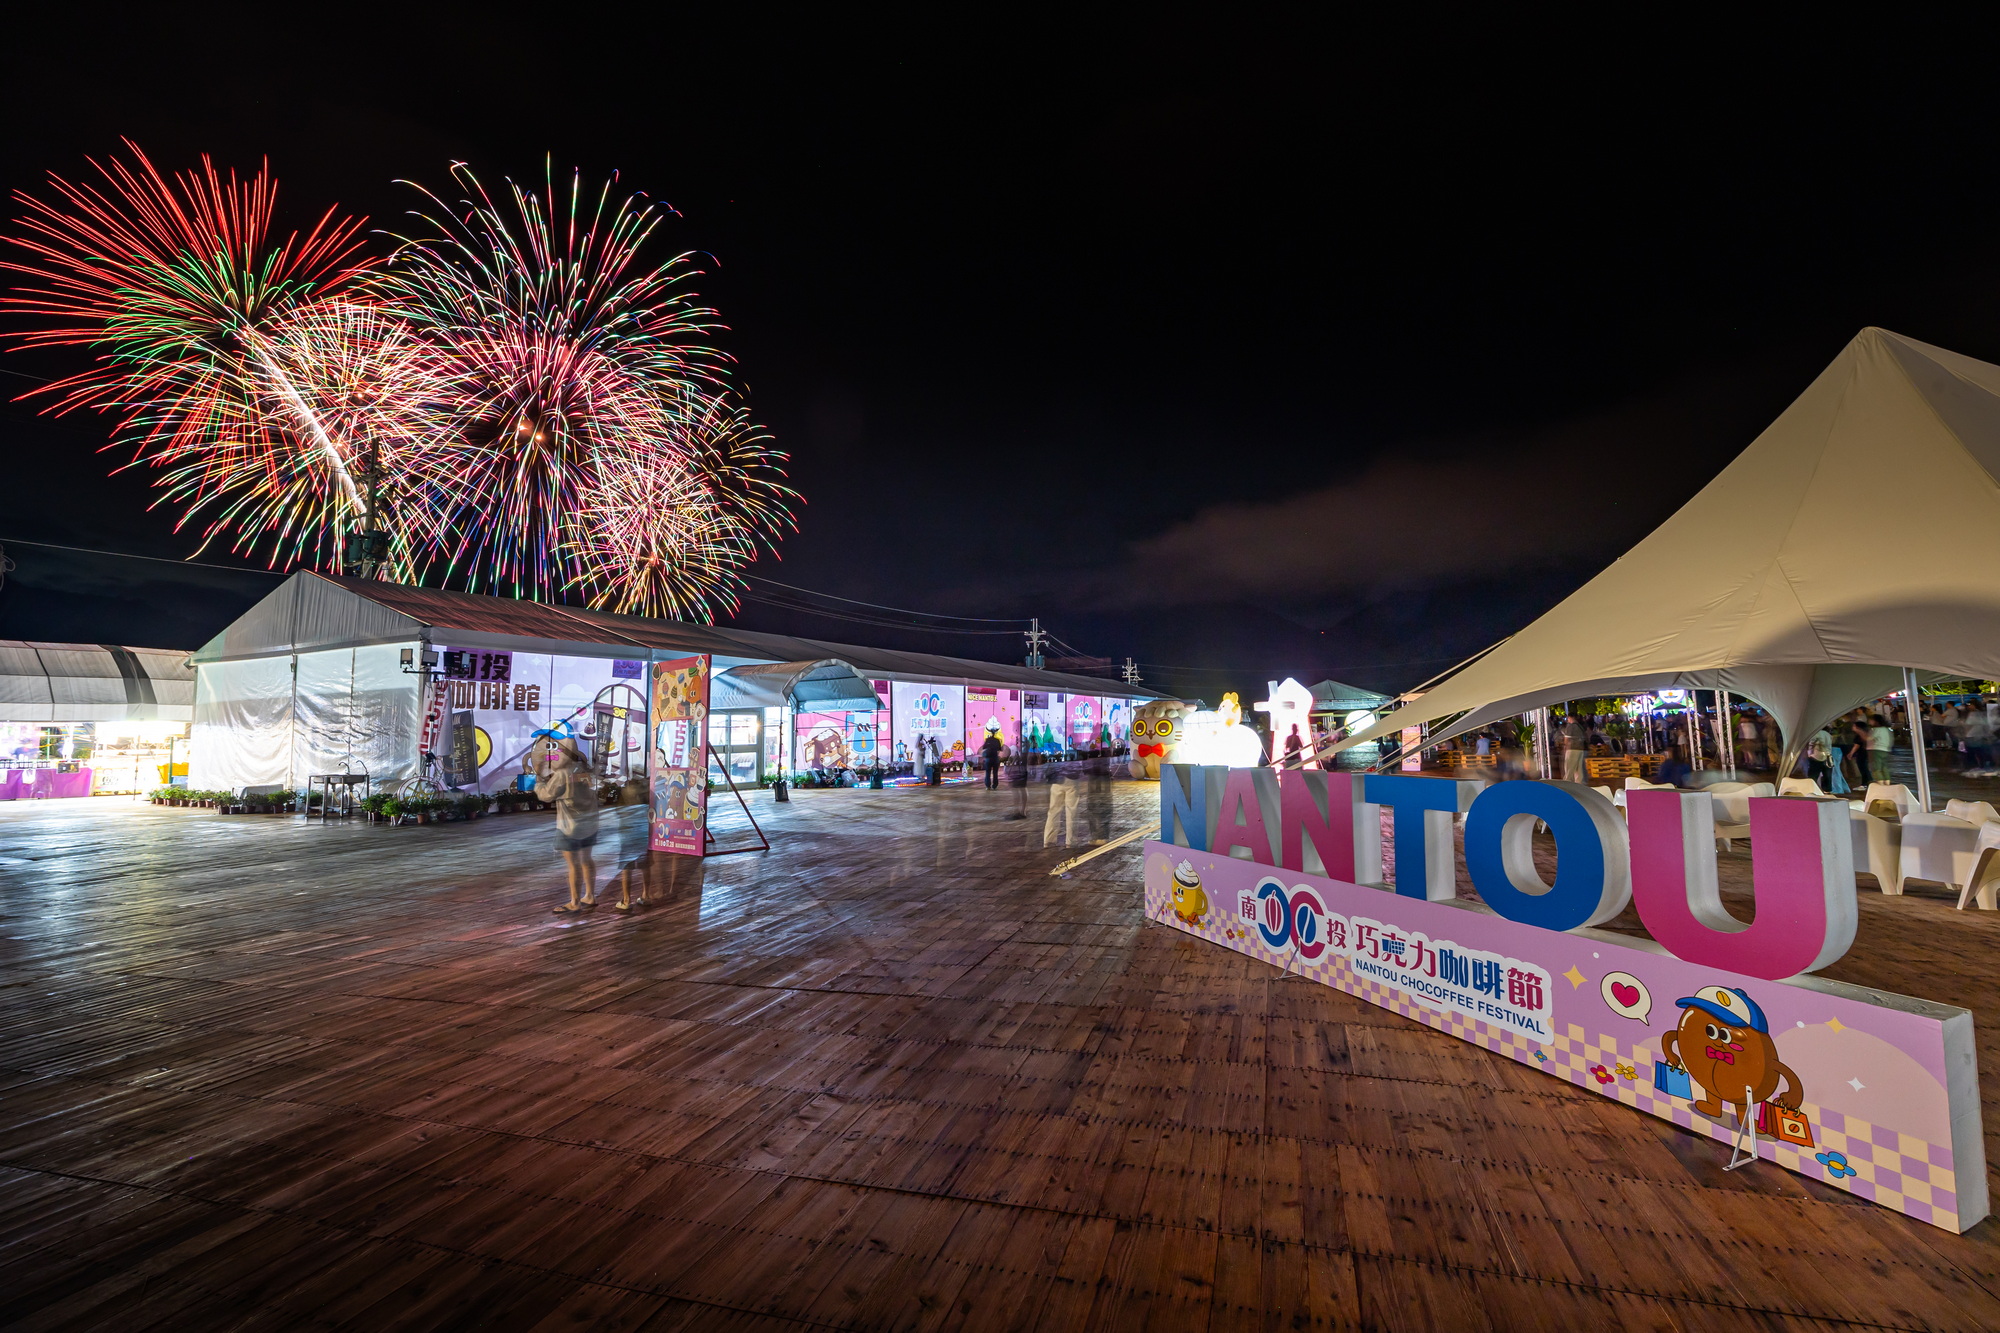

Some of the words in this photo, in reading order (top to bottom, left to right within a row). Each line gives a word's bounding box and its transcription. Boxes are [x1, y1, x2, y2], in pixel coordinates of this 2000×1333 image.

[451, 681, 541, 711] 咖啡館
[1160, 764, 1830, 981] NANTOU
[1354, 922, 1545, 1012] 巧克力咖啡節
[1355, 958, 1398, 983] NANTOU
[1400, 973, 1475, 1011] CHOCOFFEE
[1477, 1000, 1546, 1036] FESTIVAL
